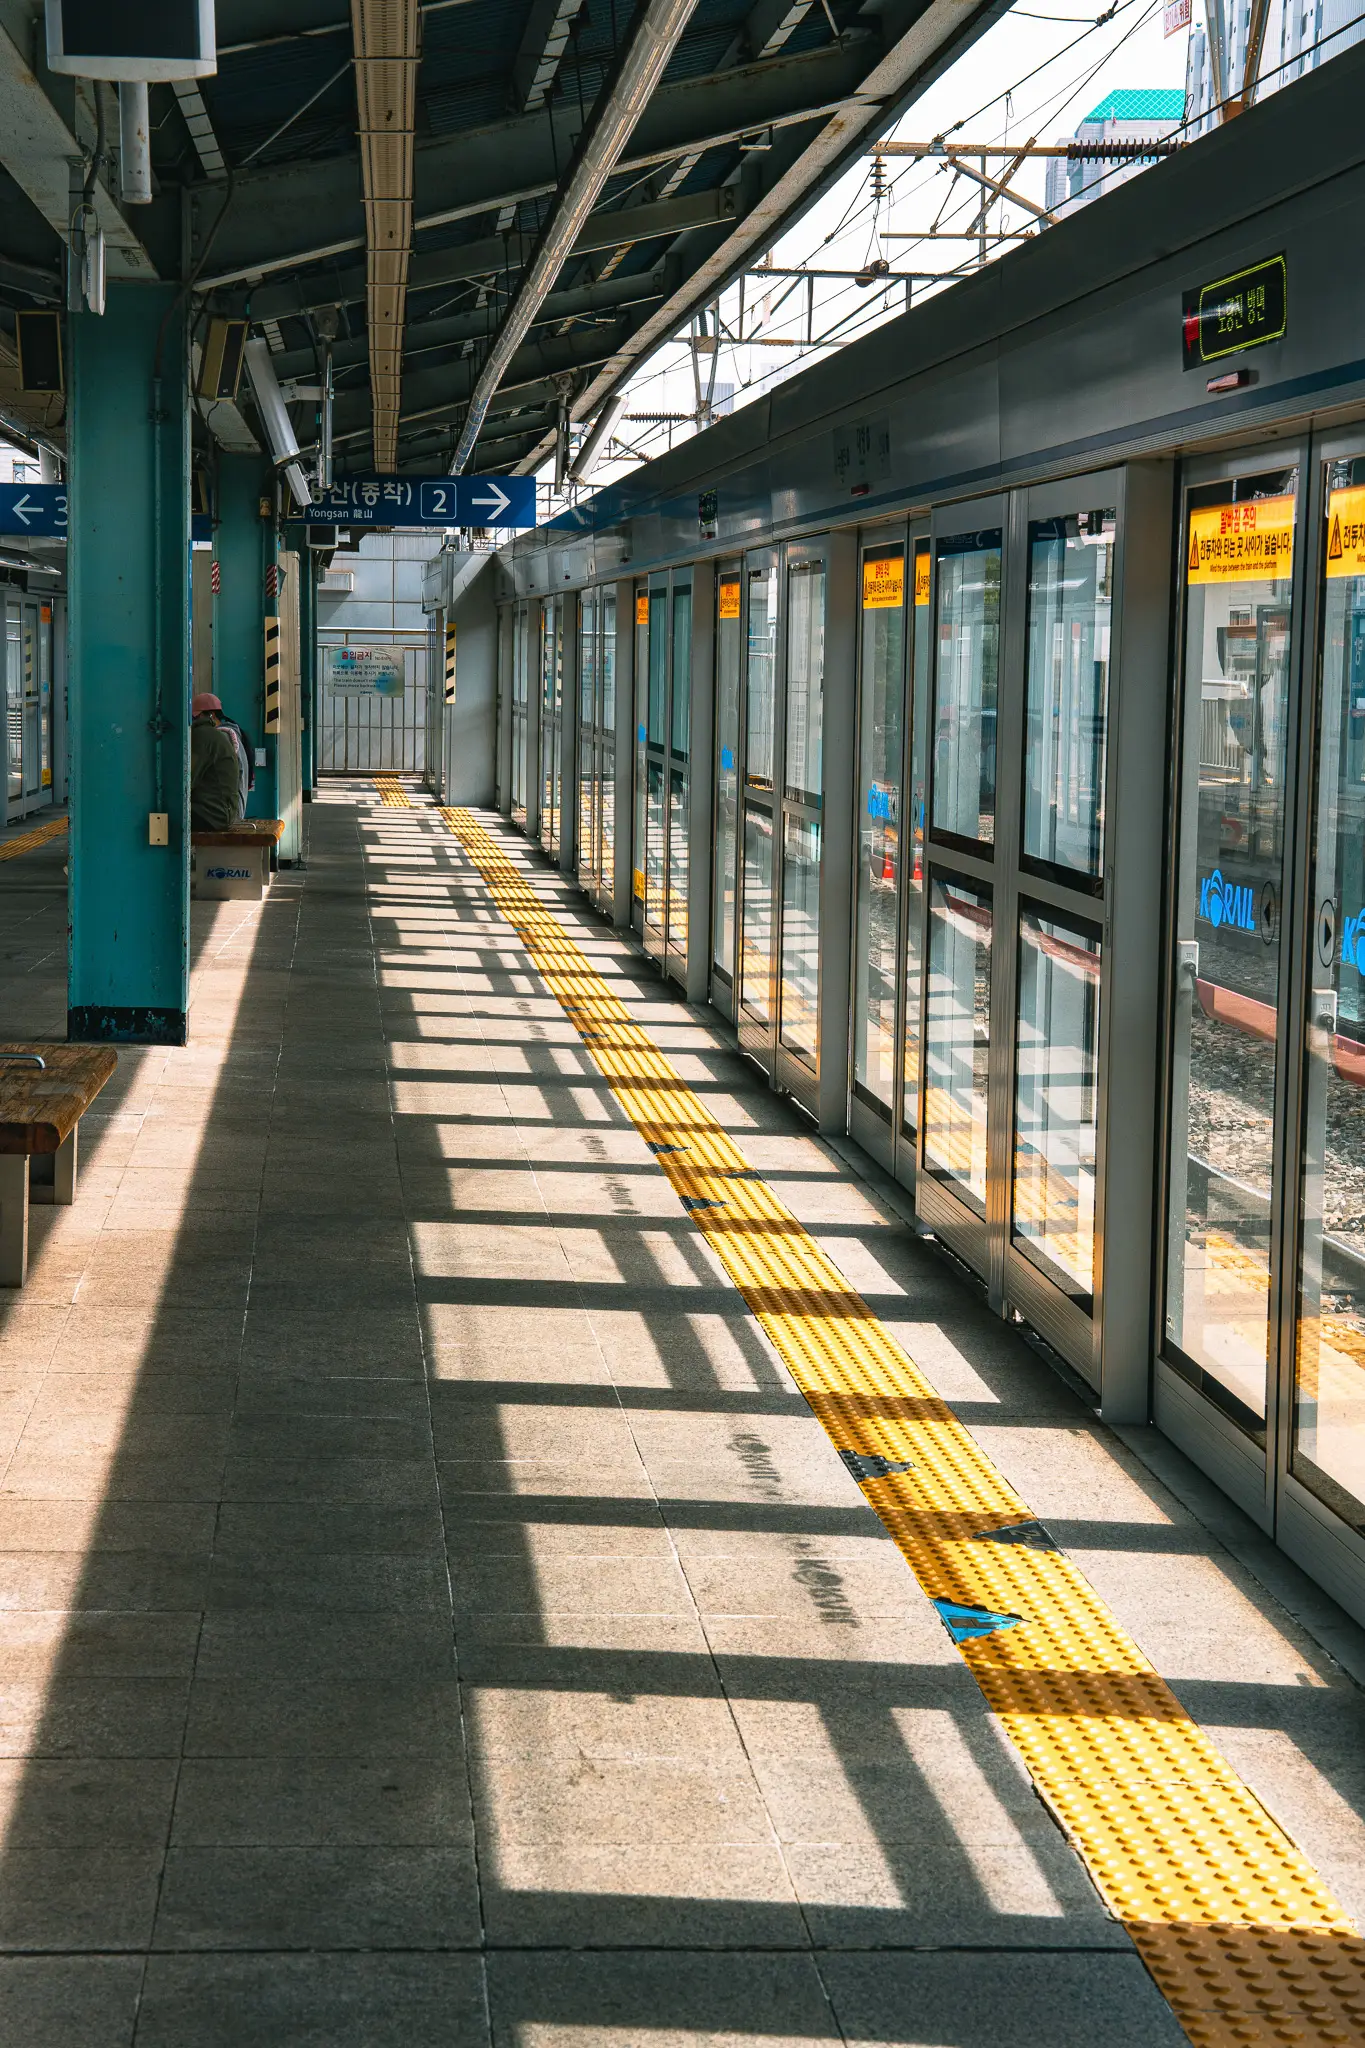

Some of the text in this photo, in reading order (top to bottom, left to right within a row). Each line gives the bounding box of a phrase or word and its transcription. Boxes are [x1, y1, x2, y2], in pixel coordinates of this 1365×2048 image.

[1247, 285, 1265, 324] 방면
[432, 489, 447, 513] 2
[309, 508, 373, 520] Yongsan 龍山
[1220, 506, 1256, 534] 발빠짐 주의
[1200, 538, 1222, 560] 전동차와
[1224, 537, 1235, 558] 타는
[1237, 536, 1243, 557] 곳
[1244, 534, 1263, 556] 사이가
[341, 651, 372, 660] 출입금지
[207, 868, 251, 879] KORAIL
[1200, 869, 1255, 931] KORAIL
